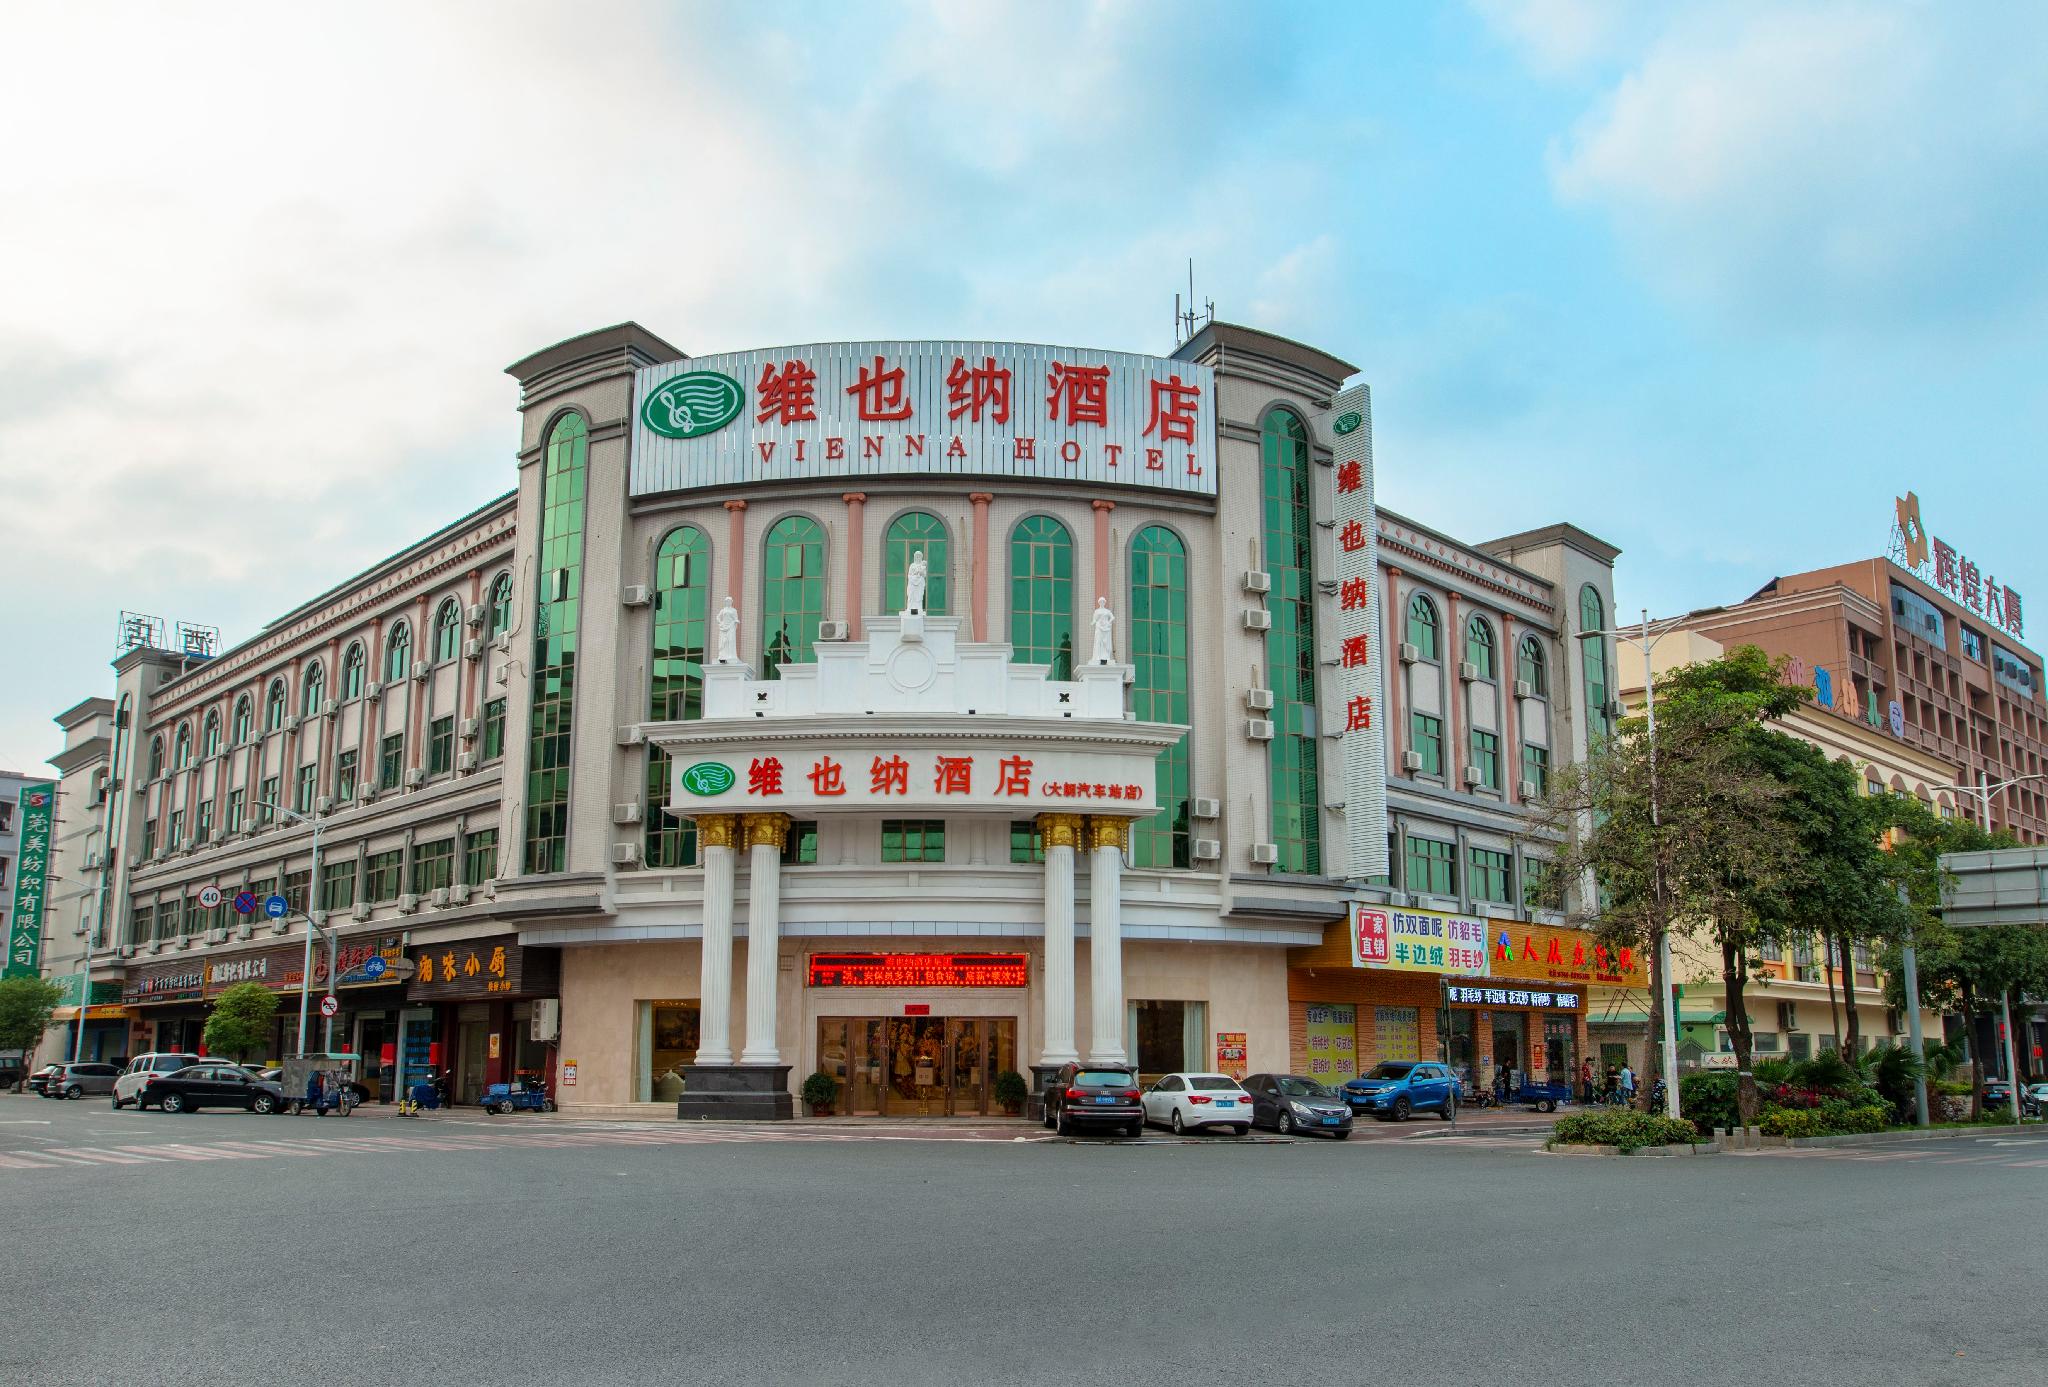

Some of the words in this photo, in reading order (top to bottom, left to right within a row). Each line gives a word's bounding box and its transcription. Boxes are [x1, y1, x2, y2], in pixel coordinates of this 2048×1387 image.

[756, 355, 1201, 446] 维也纳酒店
[757, 434, 968, 463] VIENNA
[1014, 437, 1202, 476] HOTEL
[1337, 459, 1372, 731] 维也纳酒店
[1932, 535, 2025, 640] 辉煌大厦
[748, 754, 1034, 798] 维也纳酒店
[13, 813, 49, 966] 莞美纺织有限公司
[202, 891, 218, 903] 40
[1360, 915, 1385, 934] 厂家
[1393, 912, 1443, 938] 仿双面呢
[1448, 919, 1482, 942] 仿貂毛
[1361, 936, 1385, 957] 直销
[1395, 942, 1444, 967] 半边绒
[1449, 947, 1484, 969] 羽毛纱
